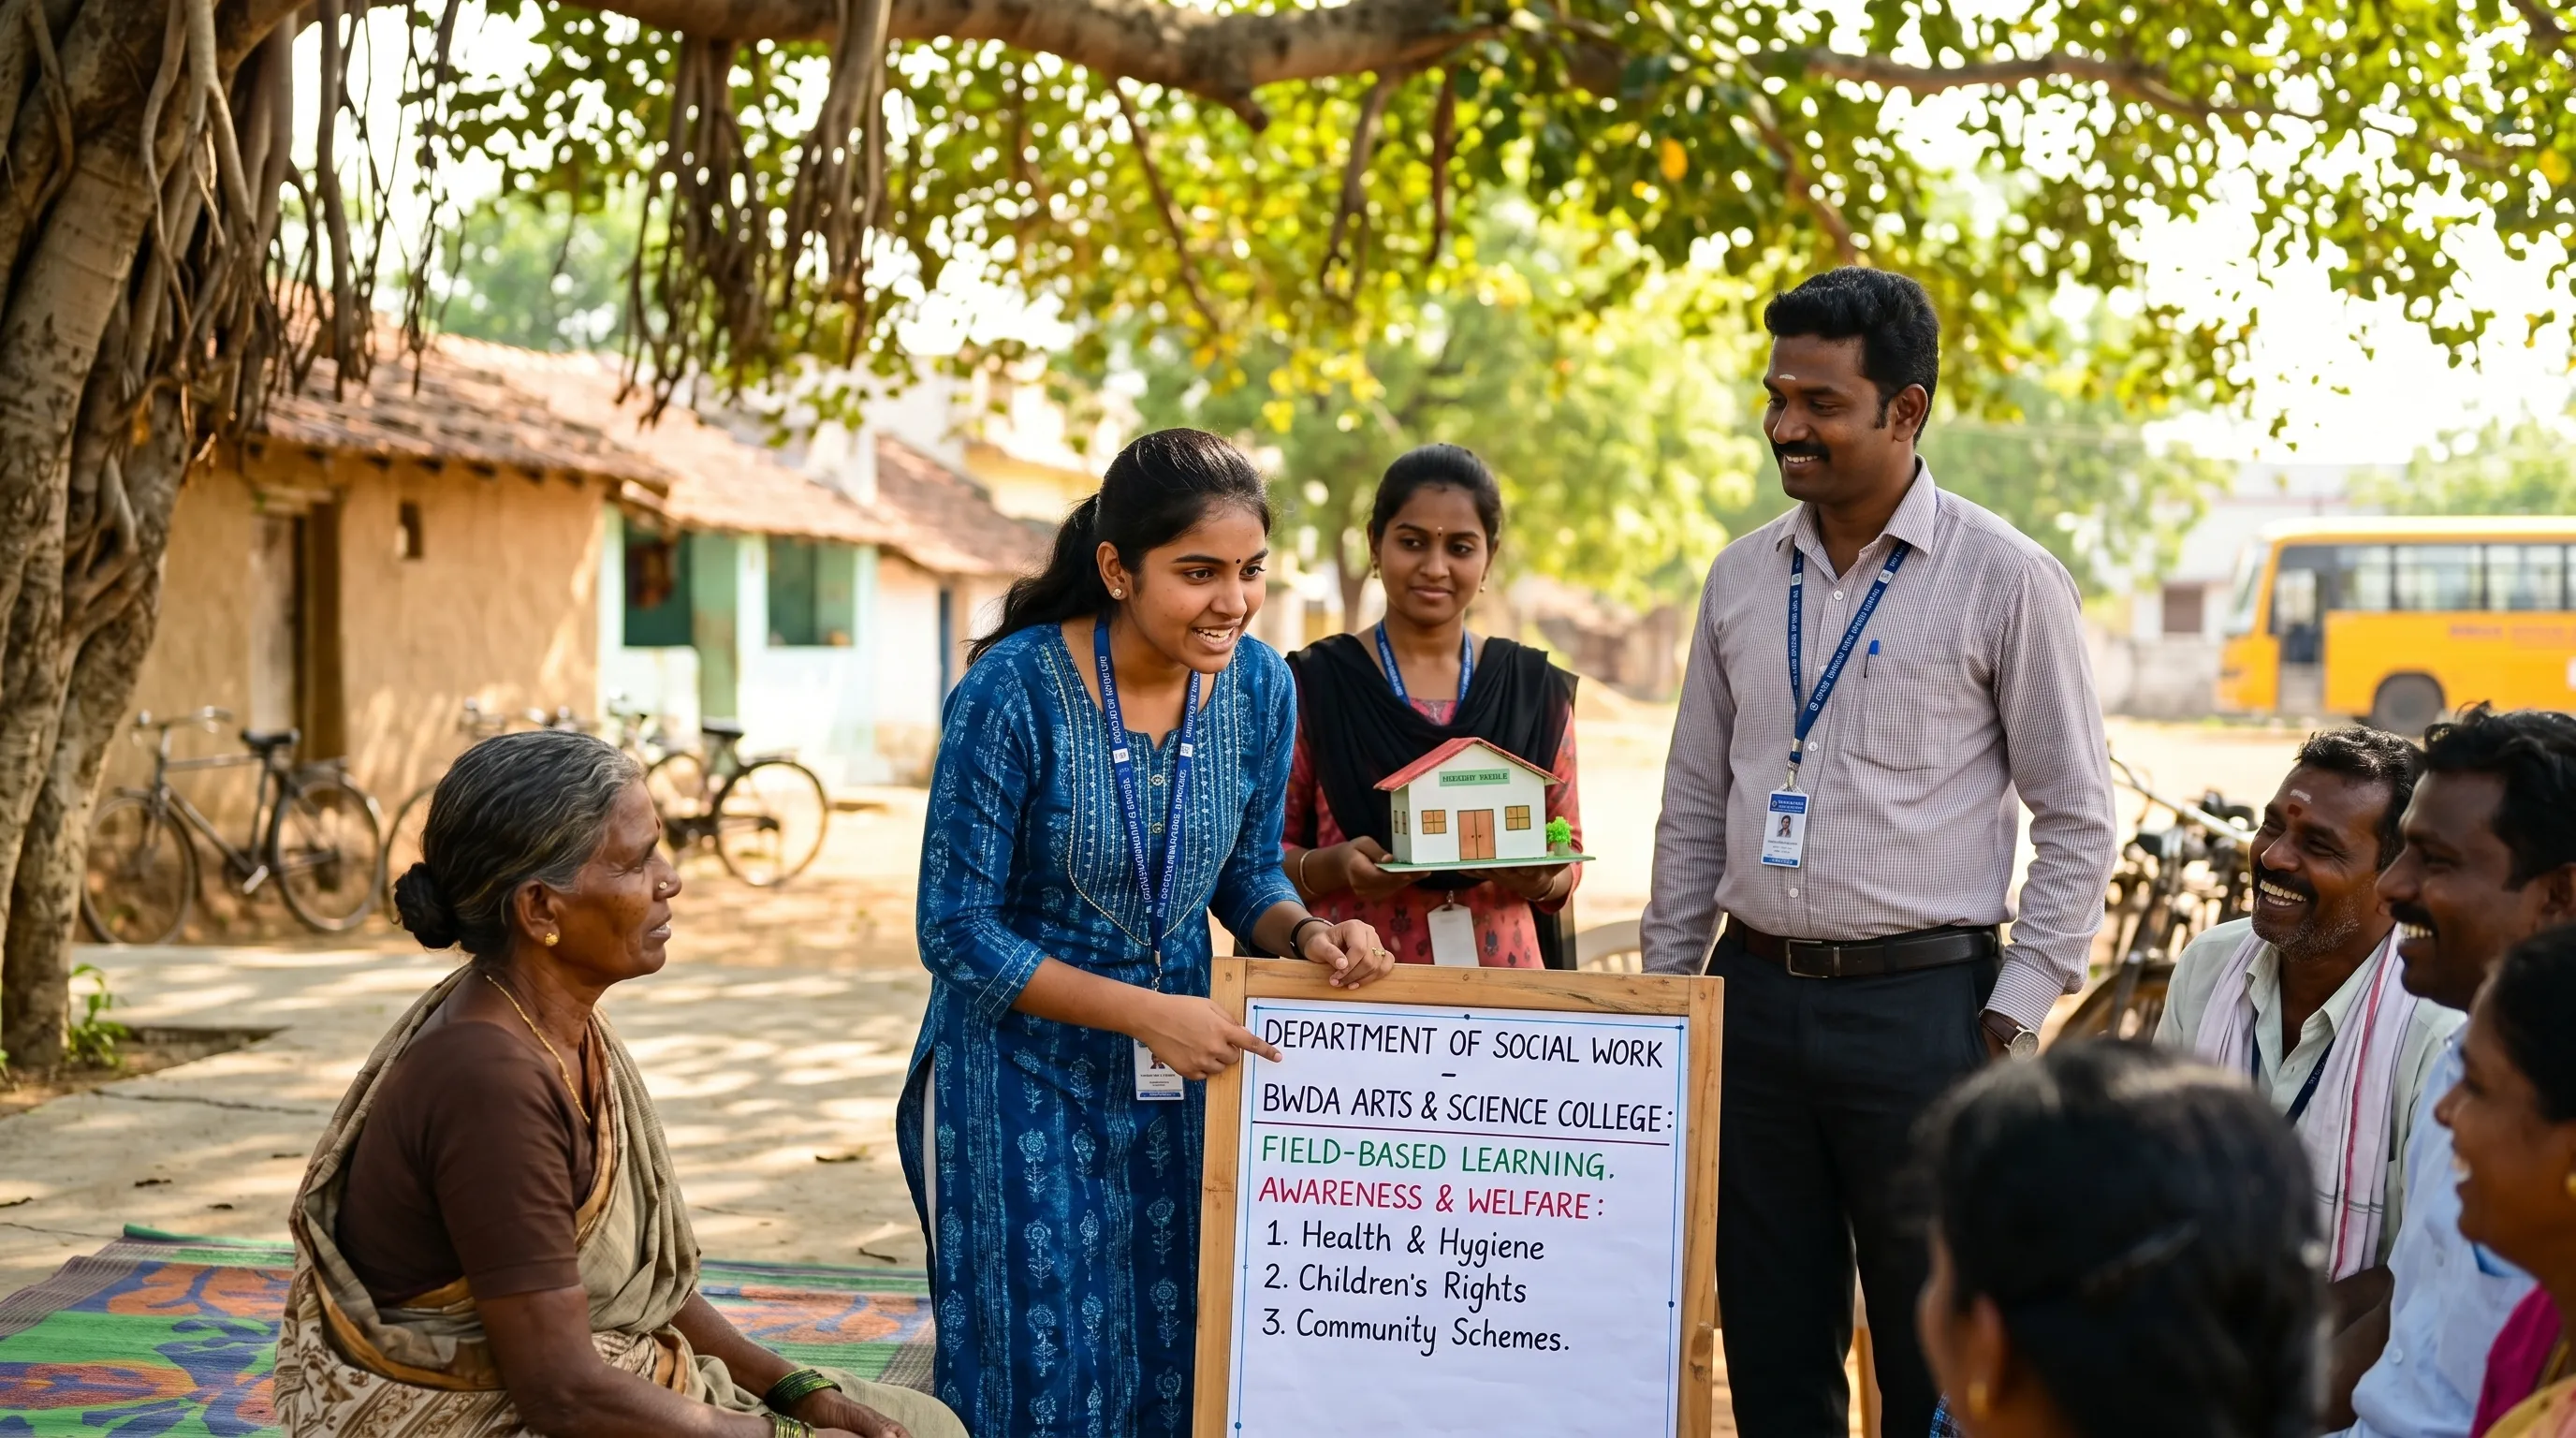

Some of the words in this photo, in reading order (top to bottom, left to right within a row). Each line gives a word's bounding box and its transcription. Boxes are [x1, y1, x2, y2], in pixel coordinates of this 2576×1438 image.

[1265, 1019, 1438, 1055] DEPARTMENT
[1449, 1029, 1483, 1057] OF
[1492, 1031, 1580, 1064] SOCIAL
[1591, 1036, 1663, 1069] WORK
[1263, 1082, 1341, 1115] BWDA
[1350, 1088, 1412, 1119] ARTS
[1420, 1091, 1438, 1122] &
[1446, 1093, 1549, 1125] SCIENCE
[1558, 1099, 1674, 1133] COLLEGE:
[1262, 1135, 1446, 1170] FIELD-BASED
[1461, 1146, 1615, 1181] LEARNING.
[1258, 1176, 1423, 1211] AWARENESS
[1435, 1183, 1455, 1213] &
[1266, 1219, 1288, 1247] 1.
[1302, 1219, 1392, 1253] Health
[1406, 1225, 1426, 1255] &
[1440, 1226, 1544, 1269] Hygiene
[1264, 1263, 1288, 1290] 2.
[1298, 1263, 1427, 1298] Children's
[1443, 1270, 1527, 1314] Rights
[1262, 1307, 1286, 1336] 3.
[1296, 1308, 1437, 1357] Community
[1451, 1316, 1571, 1352] Schemes.
